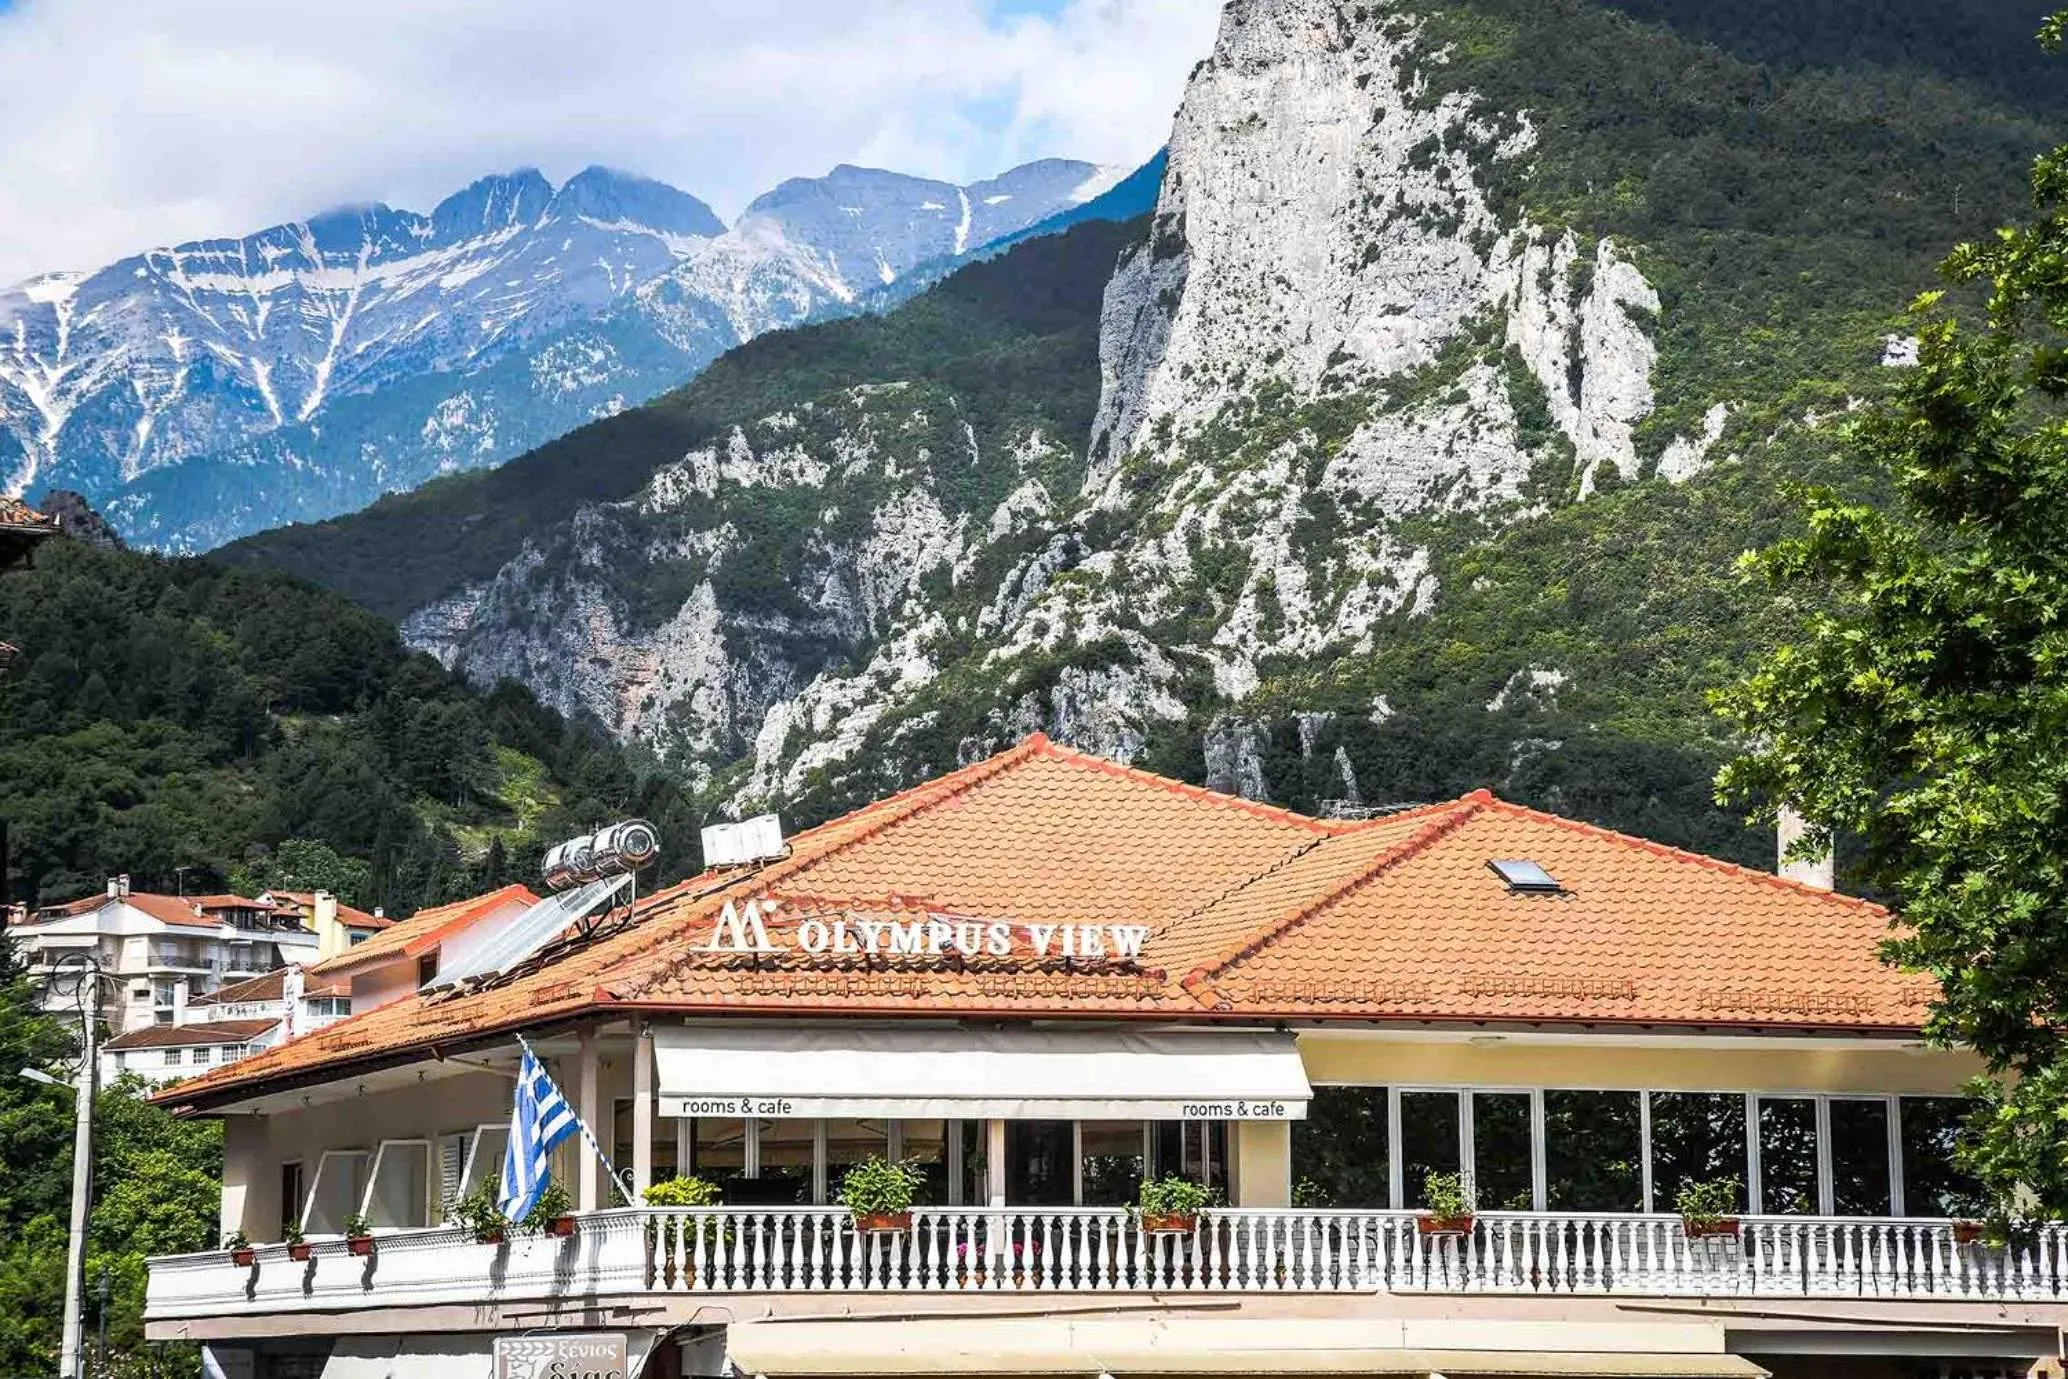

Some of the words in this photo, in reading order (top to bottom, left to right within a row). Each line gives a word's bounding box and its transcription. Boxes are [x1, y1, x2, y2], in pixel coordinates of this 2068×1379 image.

[798, 920, 1011, 956] OLYMPUS
[1024, 923, 1149, 958] VIEW
[682, 1101, 736, 1113] rooms
[741, 1098, 753, 1114] &
[757, 1098, 792, 1114] cafe
[1182, 1104, 1233, 1117] rooms
[1237, 1101, 1249, 1117] &
[1252, 1101, 1285, 1117] cafe
